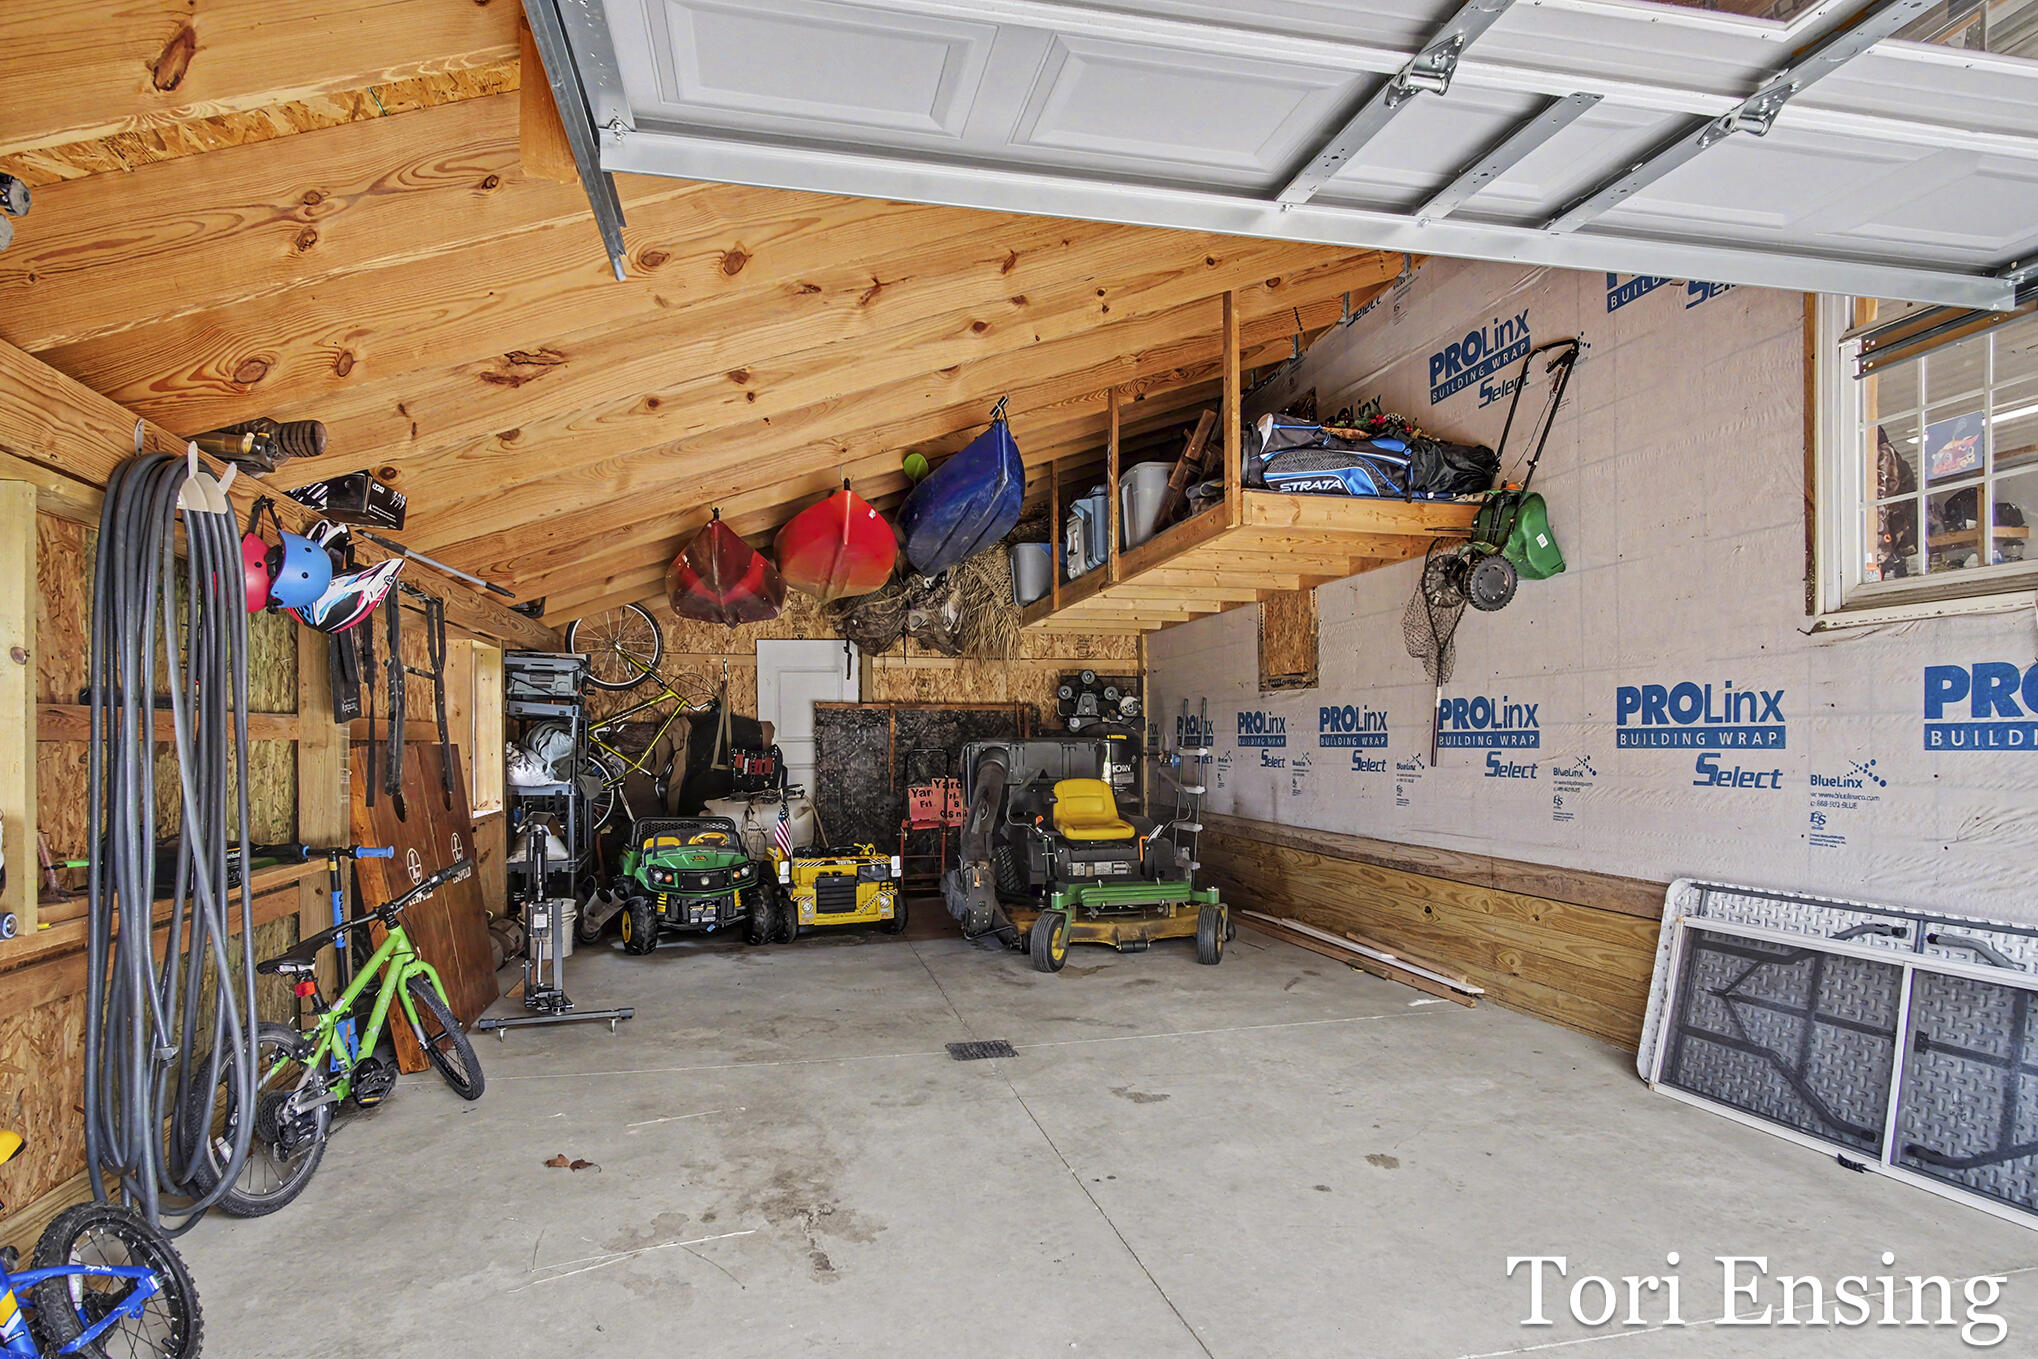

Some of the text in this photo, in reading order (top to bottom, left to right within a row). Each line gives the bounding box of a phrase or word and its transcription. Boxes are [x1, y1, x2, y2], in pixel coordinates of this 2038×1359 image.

[1429, 308, 1530, 388] PROLinx
[1432, 343, 1527, 401] BUILDING WRAP
[1280, 480, 1343, 492] STRATA
[1438, 695, 1540, 730] PROLinx
[1616, 680, 1786, 726] PROLinx
[1237, 710, 1287, 734] PROLinx
[1319, 704, 1388, 733] PROLinx
[1320, 737, 1386, 746] BUILDING WRAP
[1438, 735, 1536, 746] BUILDING WRAP
[1620, 731, 1777, 745] BUILDING WRAP
[1260, 748, 1286, 769] Select
[1351, 749, 1387, 773] Select
[1485, 751, 1538, 780] Select
[1693, 752, 1784, 790] Select
[1810, 774, 1863, 788] BlueLinx
